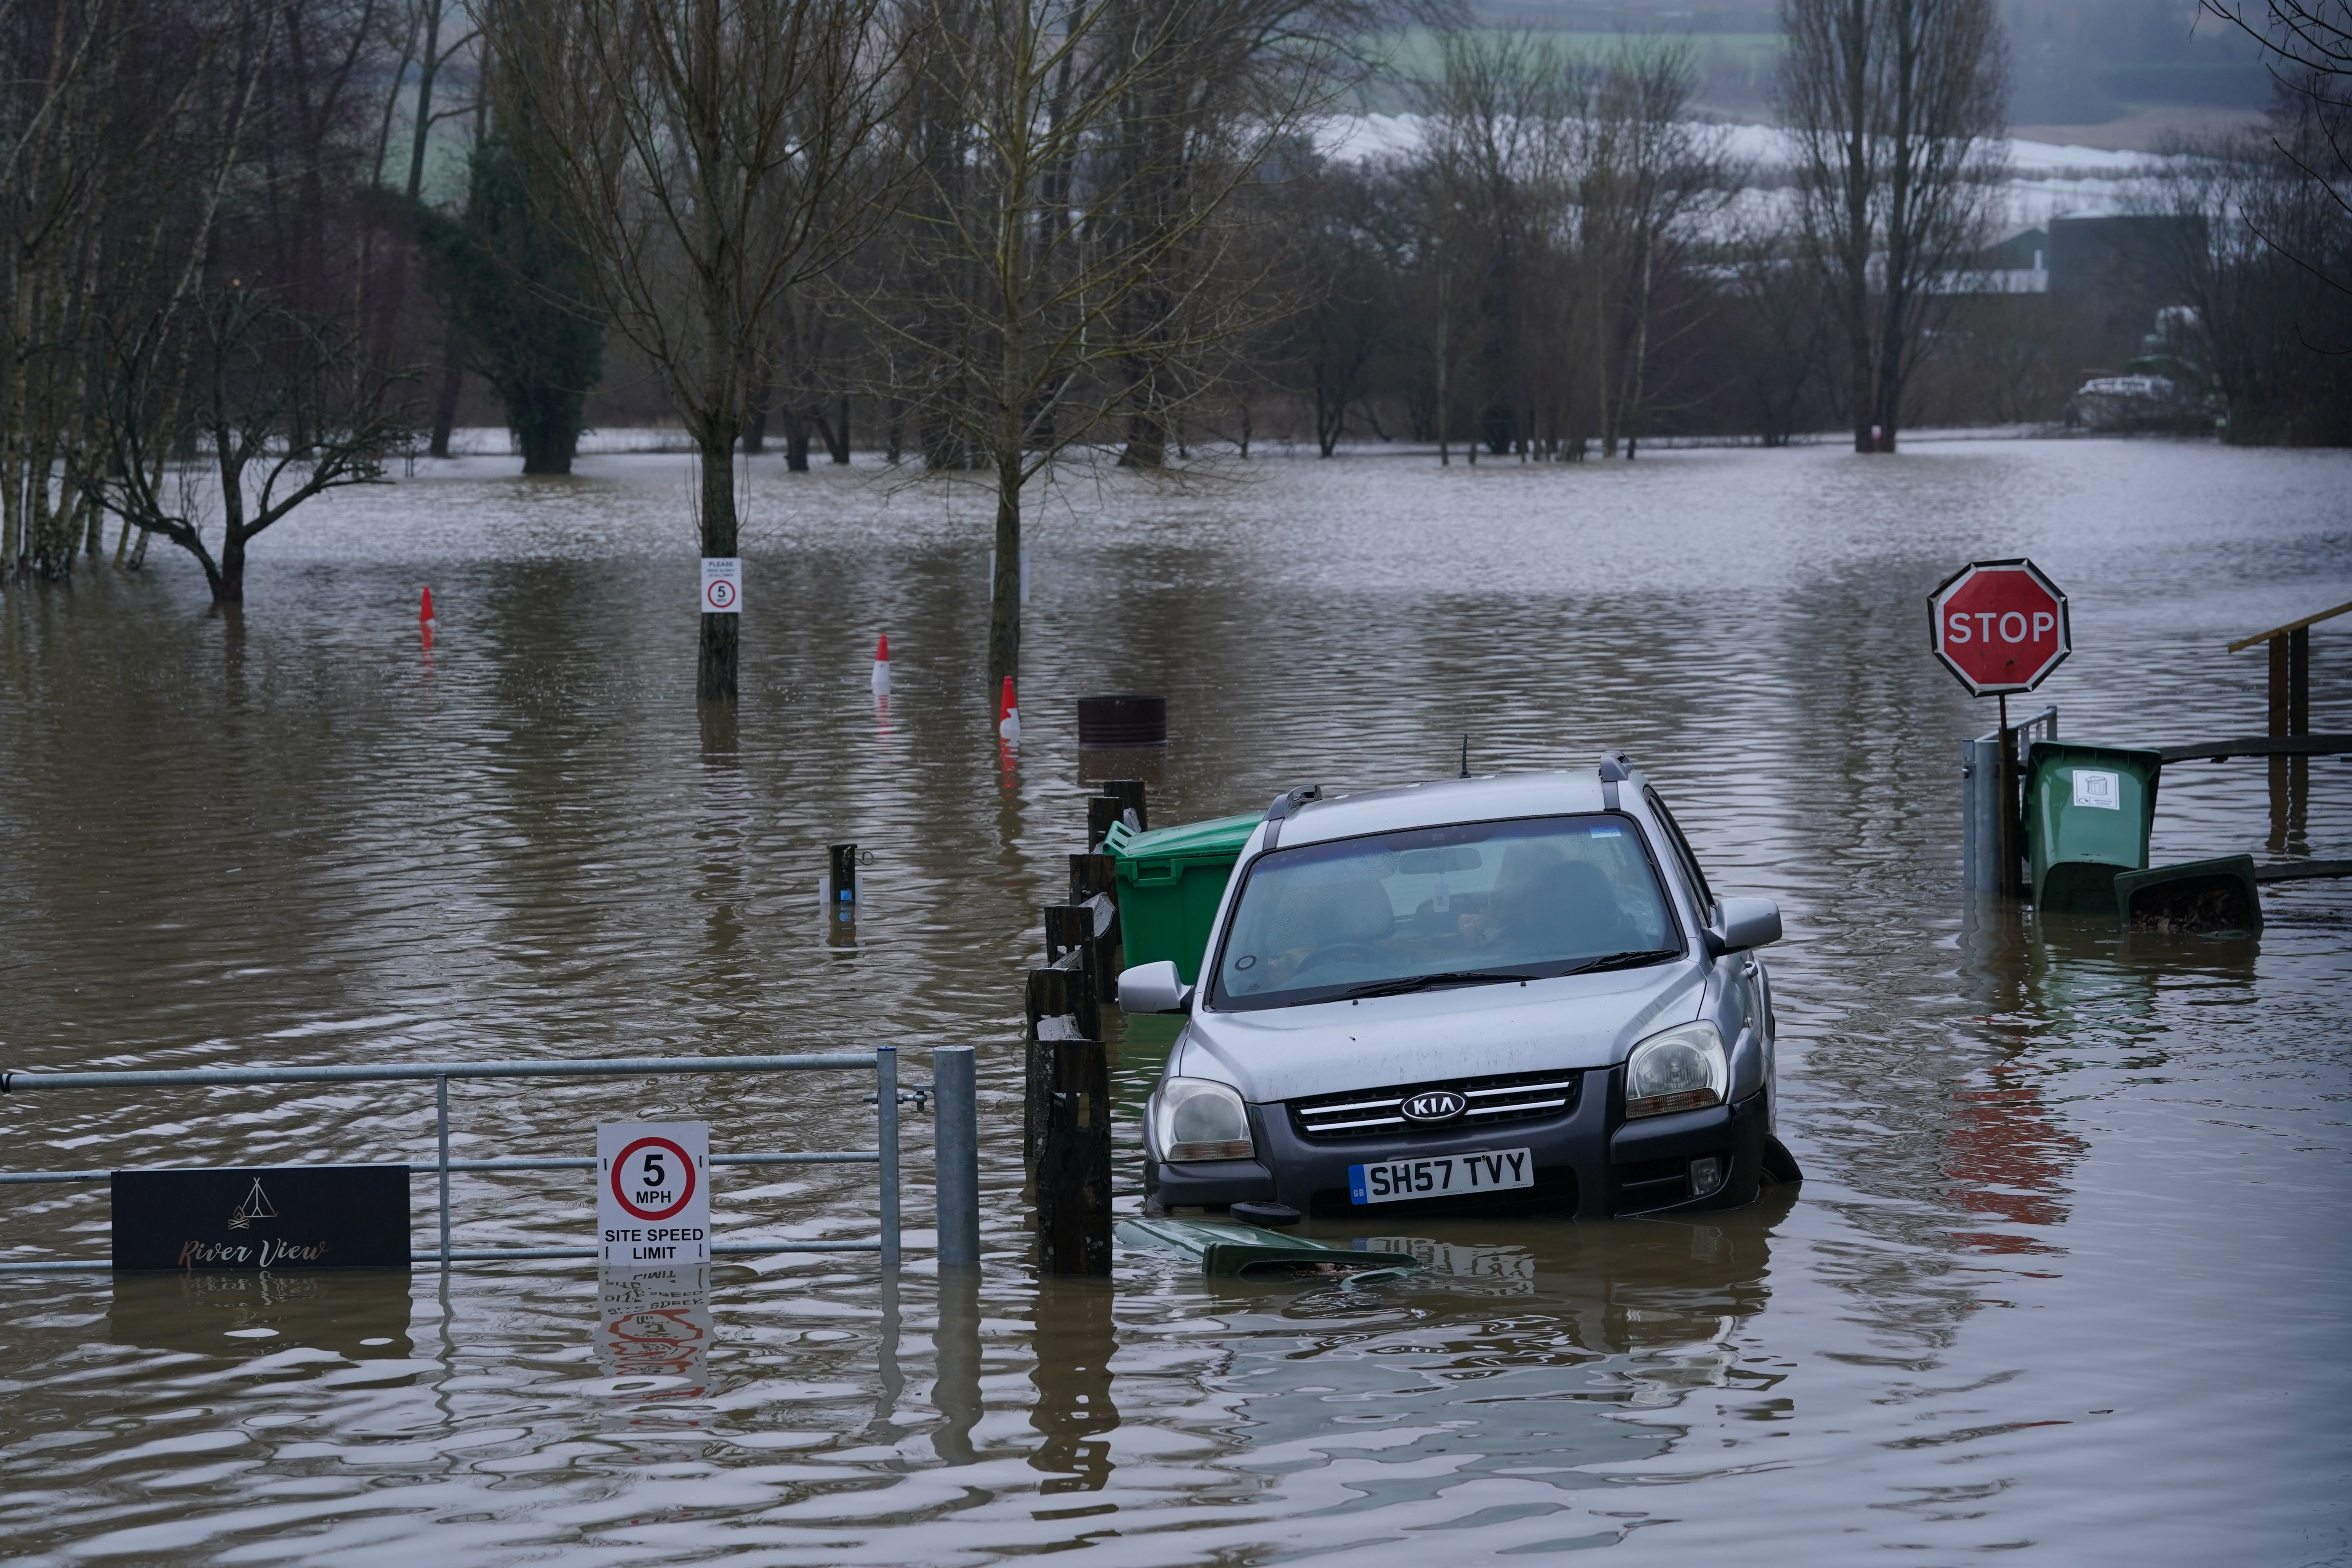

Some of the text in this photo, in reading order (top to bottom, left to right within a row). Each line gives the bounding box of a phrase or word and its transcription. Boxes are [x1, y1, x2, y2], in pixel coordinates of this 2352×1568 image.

[718, 586, 726, 598] 5
[1948, 612, 2054, 644] STOP
[1412, 1096, 1456, 1115] KIA
[642, 1154, 665, 1187] 5
[1370, 1152, 1525, 1196] SH57 TVY
[636, 1191, 671, 1204] MPH
[1353, 1189, 1364, 1197] GB
[605, 1228, 704, 1242] SITE SPEED
[178, 1238, 329, 1269] River View
[633, 1247, 677, 1259] LIMIT
